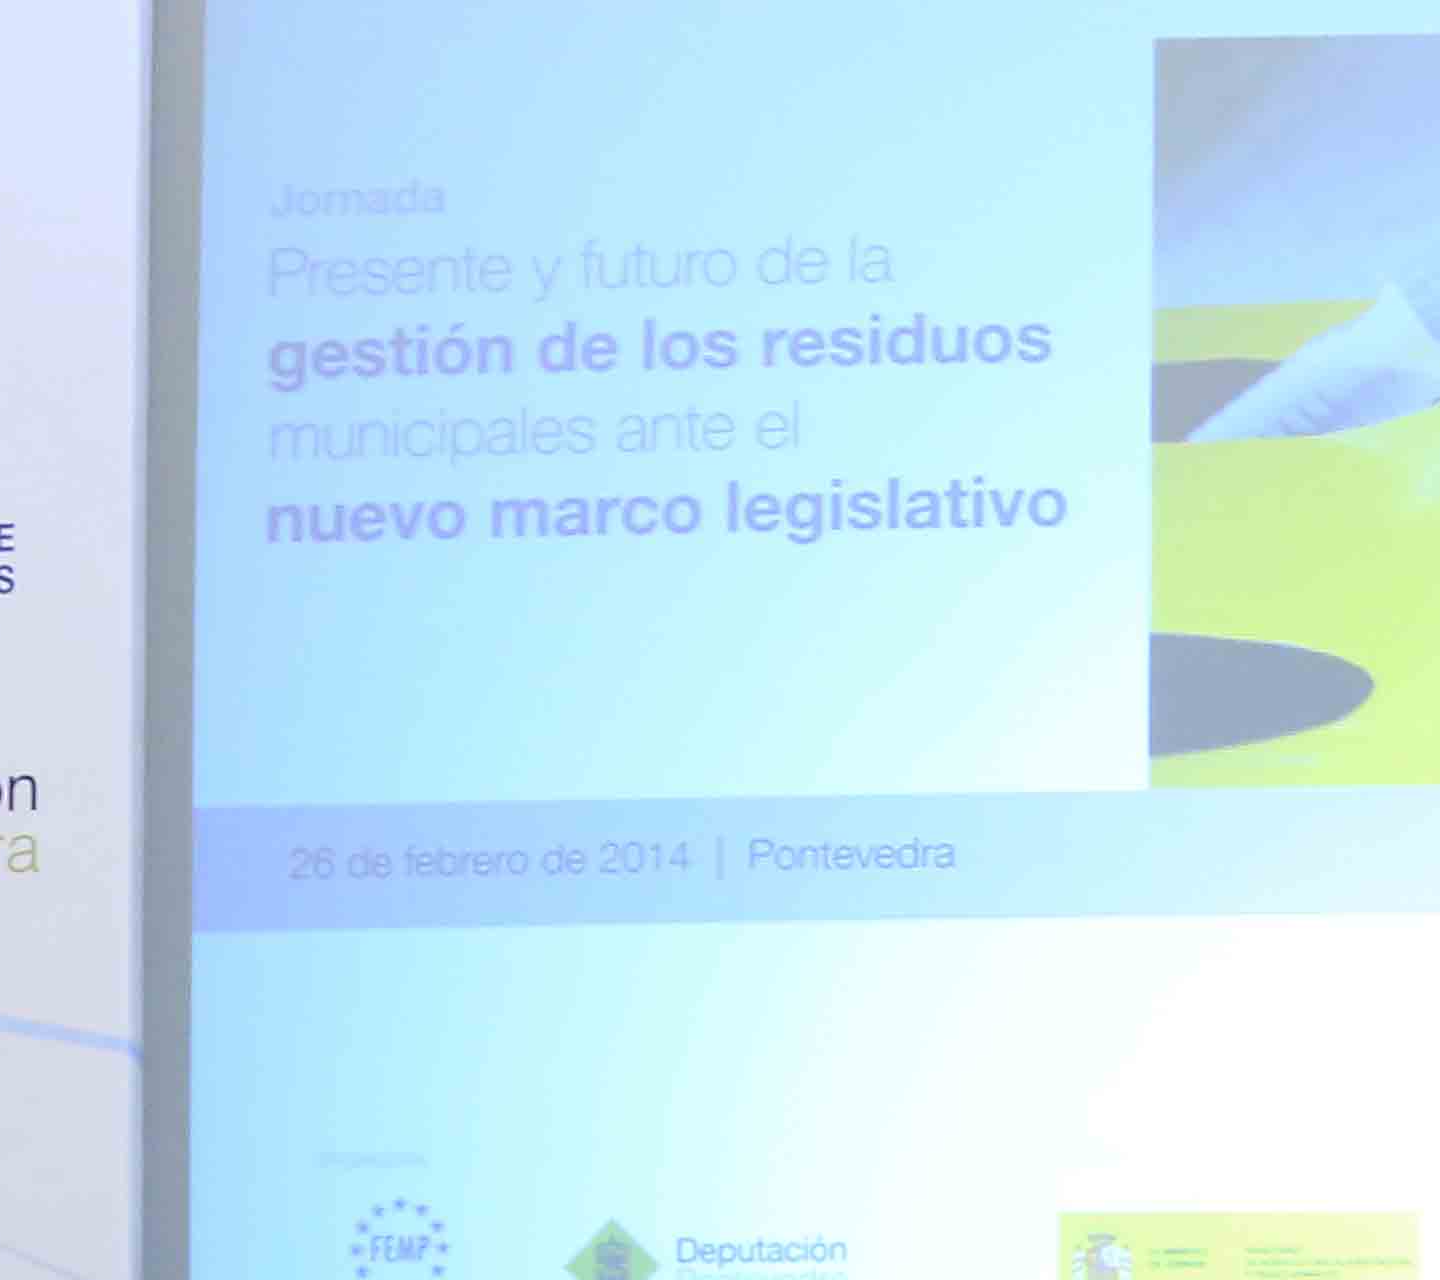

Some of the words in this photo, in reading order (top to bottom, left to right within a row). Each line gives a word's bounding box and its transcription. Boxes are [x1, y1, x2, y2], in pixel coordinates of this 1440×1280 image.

[267, 245, 512, 297] Presente
[531, 255, 563, 301] y
[579, 238, 738, 289] futuro
[756, 232, 830, 286] de
[848, 233, 896, 285] la
[268, 321, 515, 393] gestión
[538, 319, 619, 373] de
[641, 316, 739, 371] los
[761, 311, 1054, 368] residuos
[267, 406, 597, 467] municipales
[616, 405, 737, 453] ante
[755, 398, 801, 450] el
[265, 497, 466, 544] nuevo
[490, 492, 703, 539] marco
[726, 474, 1069, 545] legislativo
[287, 845, 336, 881] 26
[348, 845, 392, 880] de
[404, 844, 529, 879] febrero
[541, 842, 587, 876] de
[598, 839, 690, 876] 2014
[747, 836, 958, 874] Pontevedra
[369, 1234, 431, 1263] FEMP
[675, 1232, 848, 1269] Deputación
